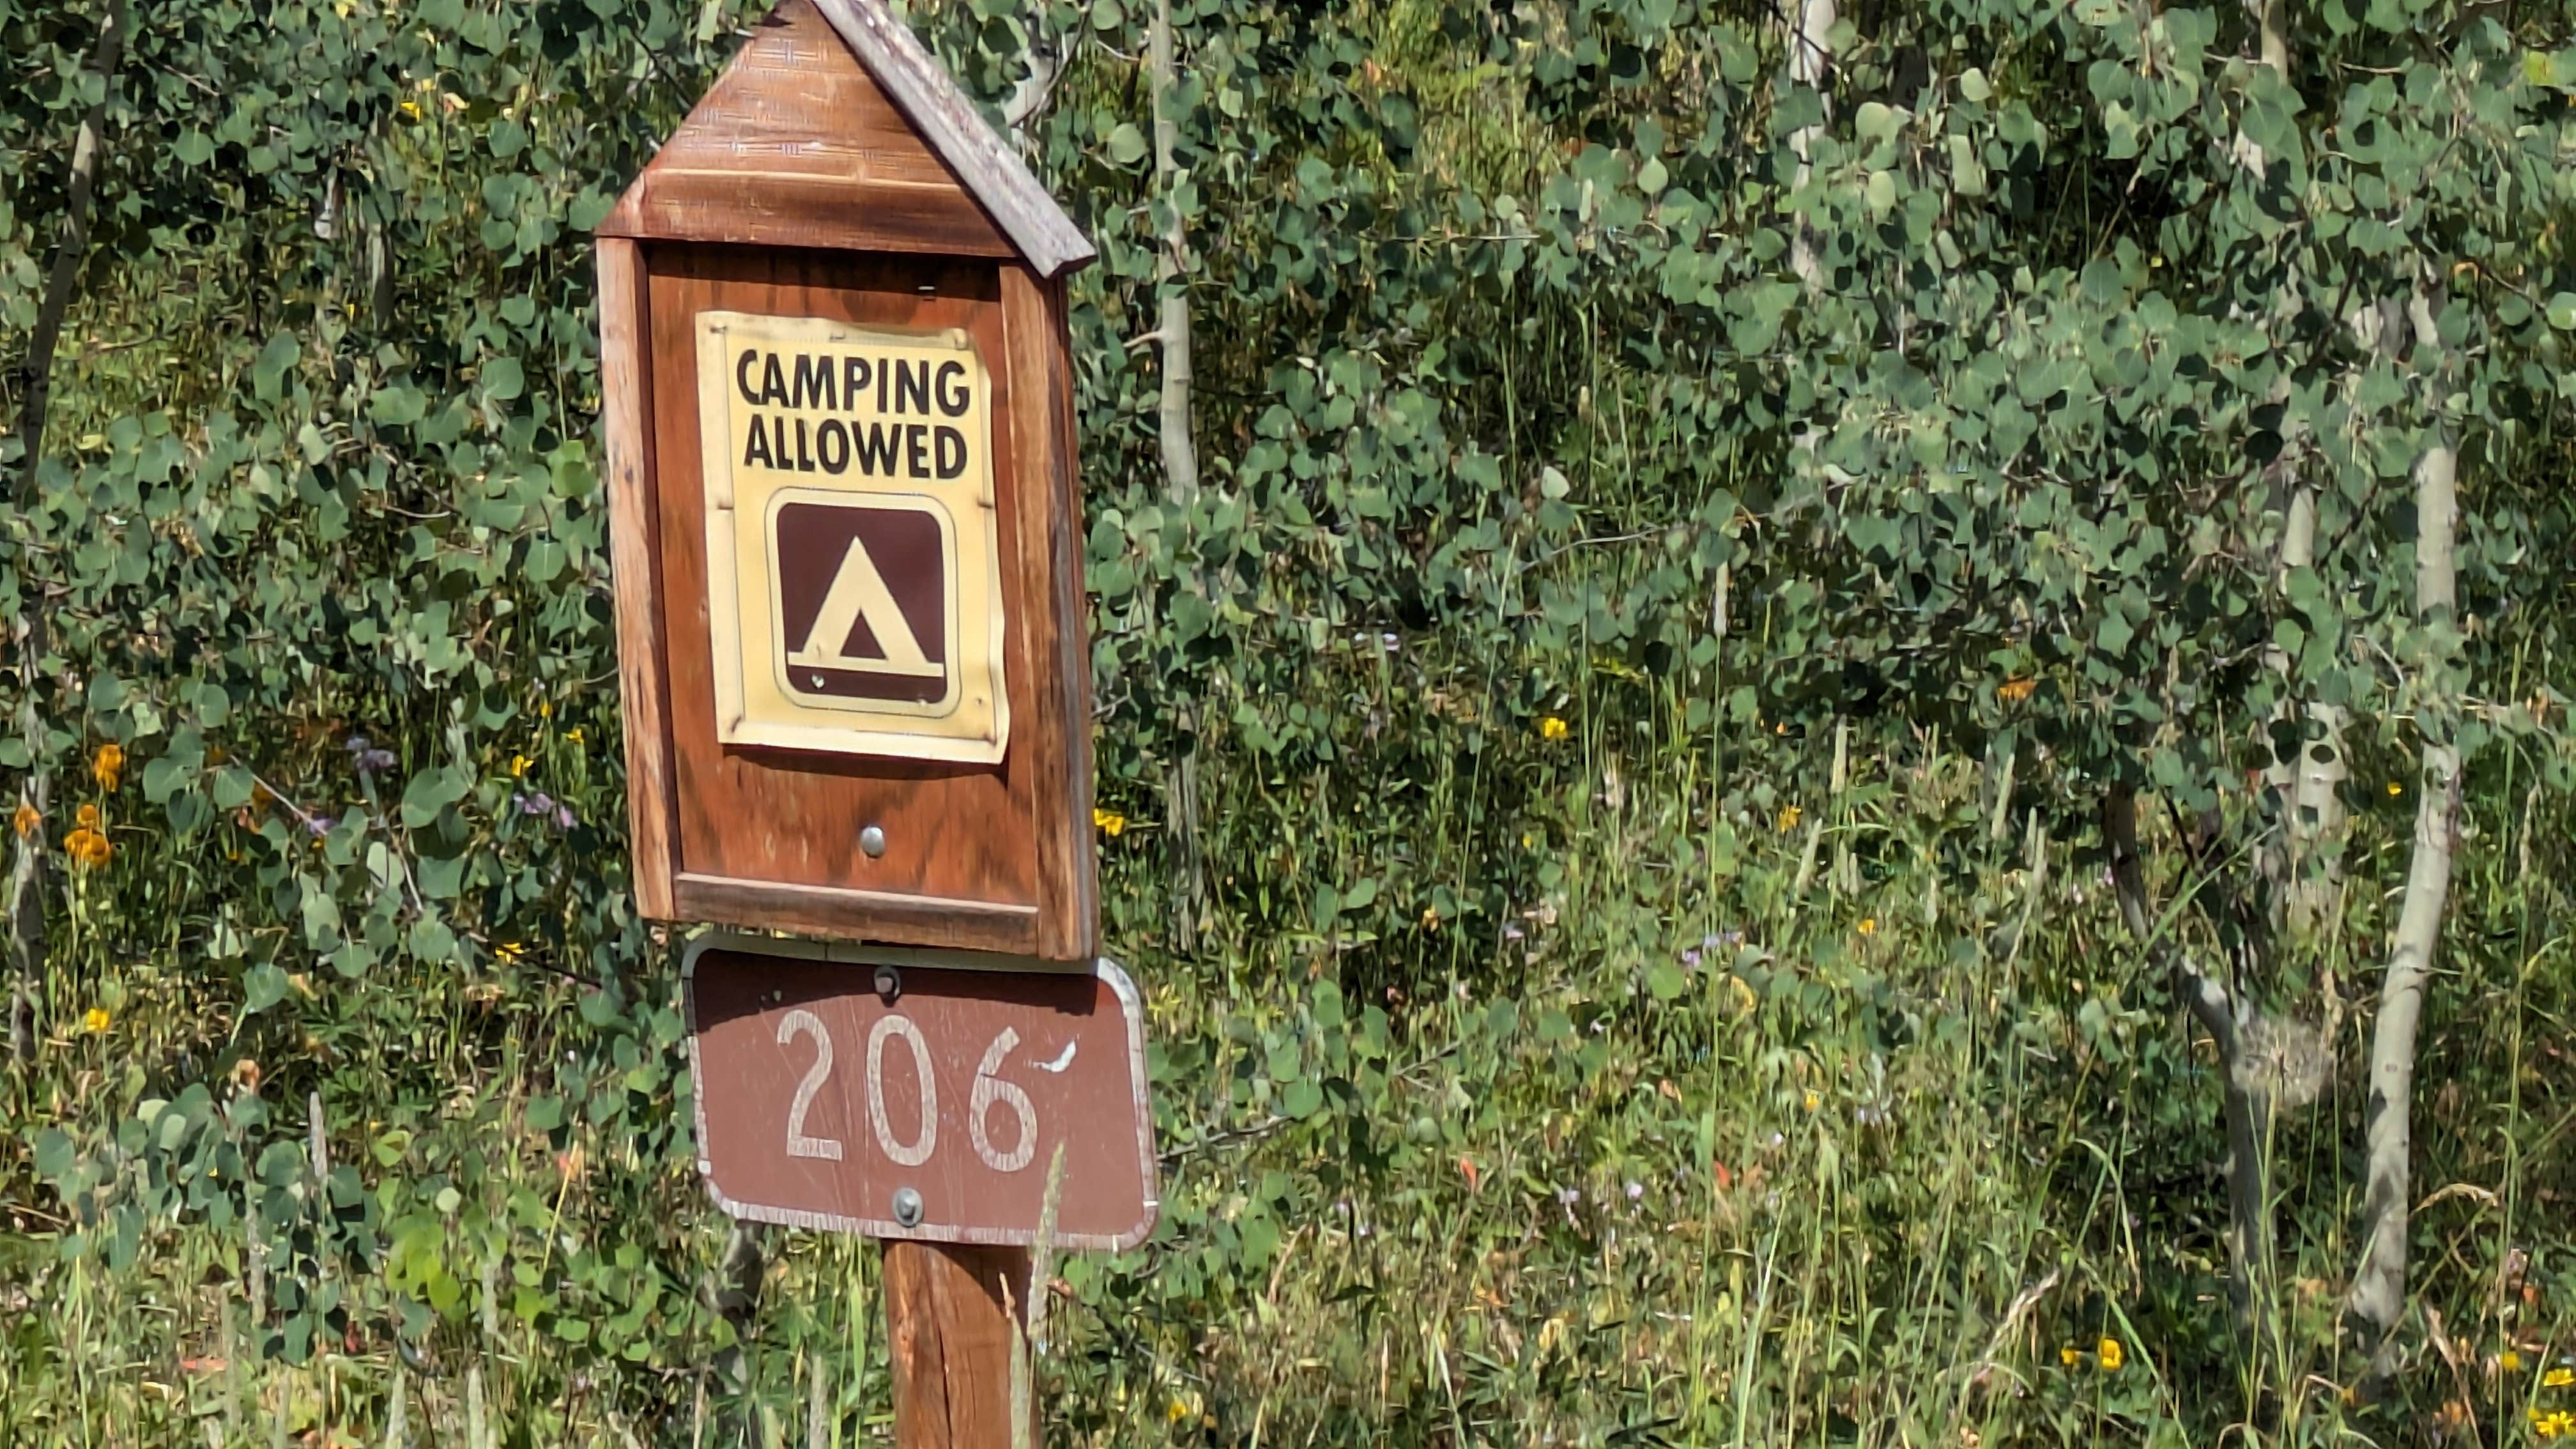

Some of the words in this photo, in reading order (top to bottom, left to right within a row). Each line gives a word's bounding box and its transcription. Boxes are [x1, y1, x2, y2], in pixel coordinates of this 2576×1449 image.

[736, 349, 970, 417] CAMPING
[744, 413, 968, 479] ALLOWED
[777, 1009, 1038, 1172] 206
